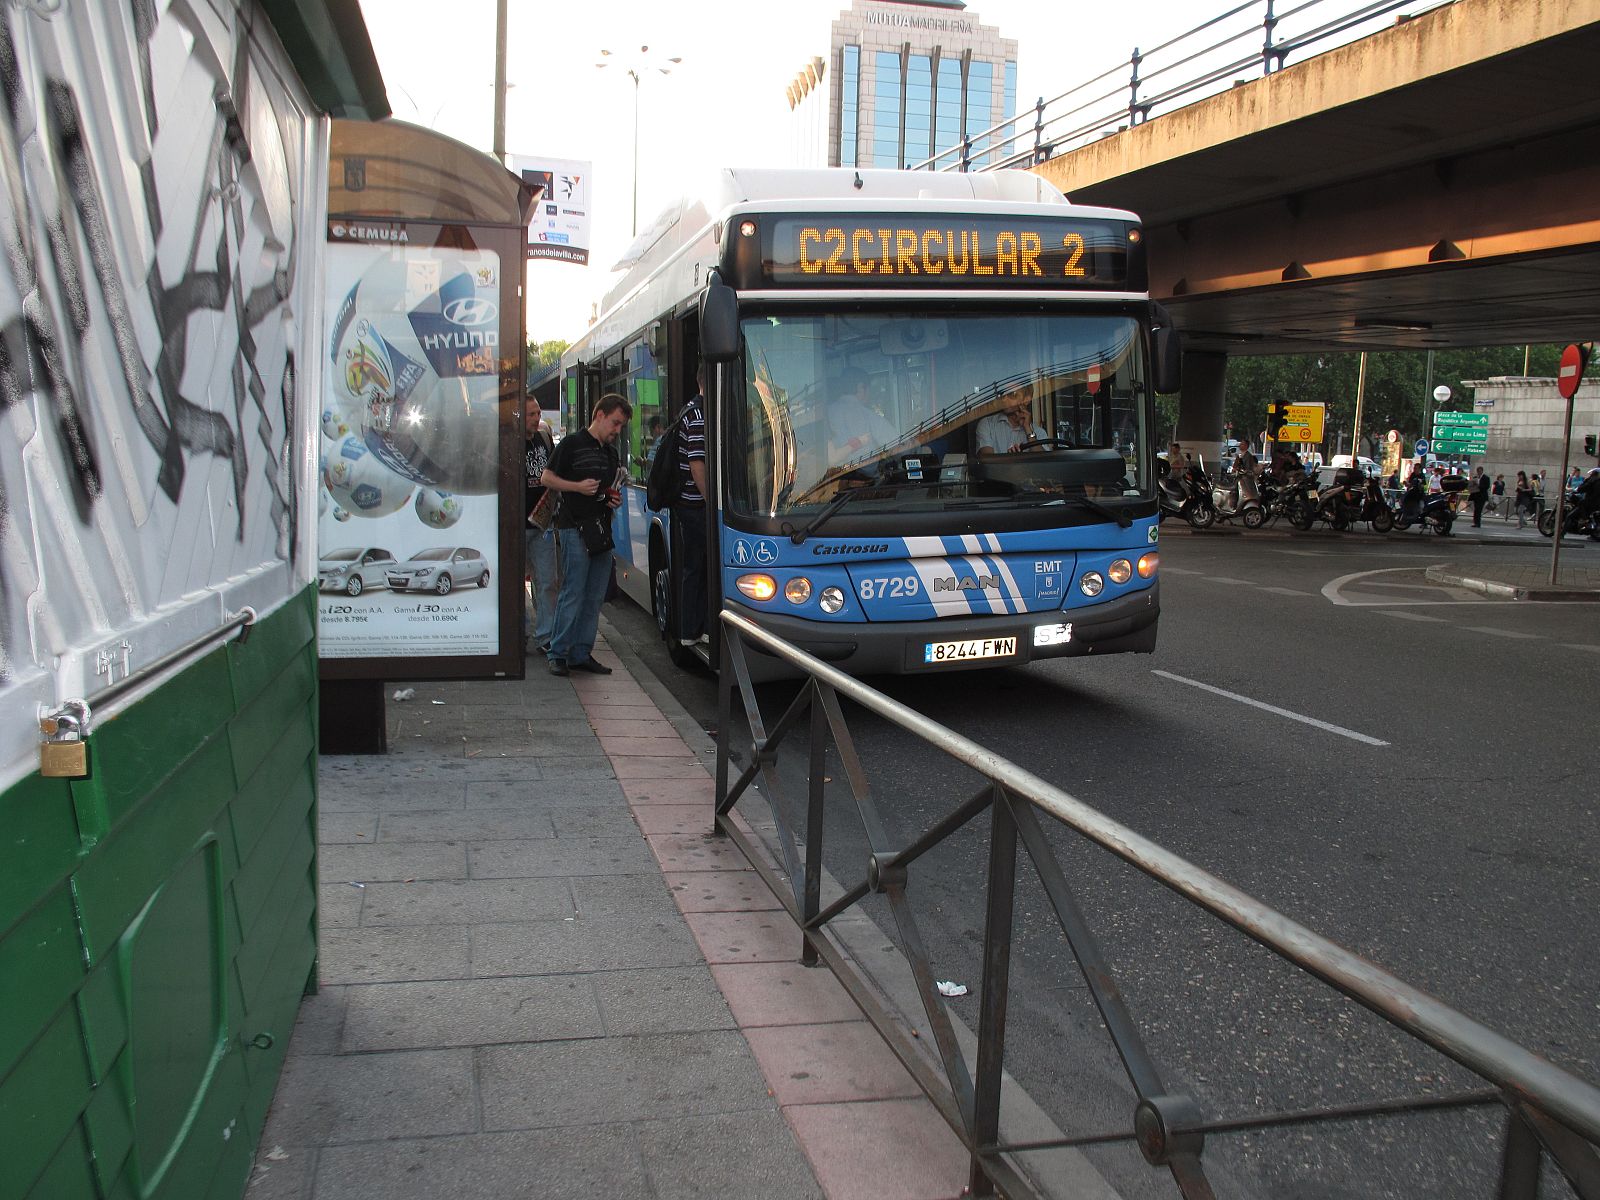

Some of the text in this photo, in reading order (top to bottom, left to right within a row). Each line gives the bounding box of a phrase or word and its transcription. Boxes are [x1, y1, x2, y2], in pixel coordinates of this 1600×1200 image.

[350, 228, 409, 241] CEMUSA
[1063, 233, 1085, 276] 2
[812, 544, 889, 556] Castrosua
[1034, 560, 1062, 573] EMT
[860, 576, 919, 600] 8729
[933, 575, 1000, 592] MAN
[394, 606, 416, 614] Gama
[936, 639, 1014, 660] 8244 FWN
